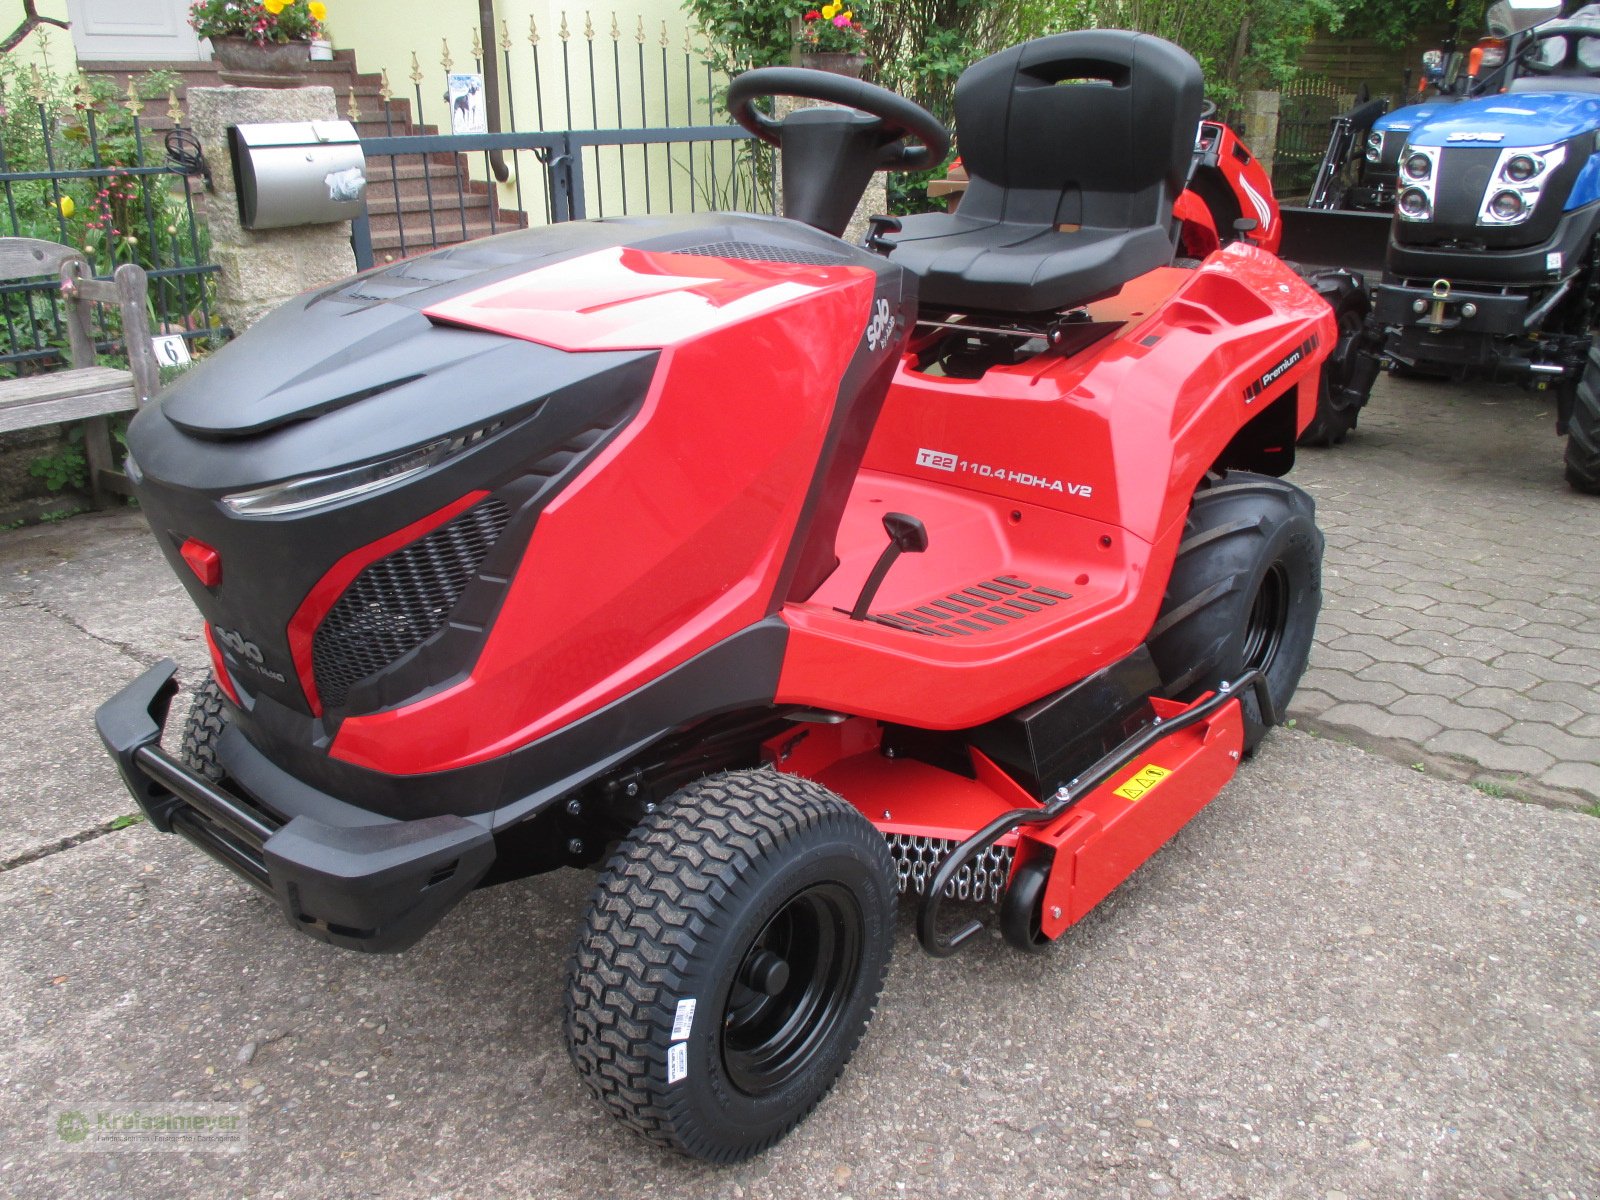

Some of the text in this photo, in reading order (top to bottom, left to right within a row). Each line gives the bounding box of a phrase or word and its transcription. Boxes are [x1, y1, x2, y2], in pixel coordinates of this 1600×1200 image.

[164, 340, 179, 363] 6
[1262, 352, 1300, 386] Premium
[921, 453, 1093, 498] T 22 110.4 HDH-A V2
